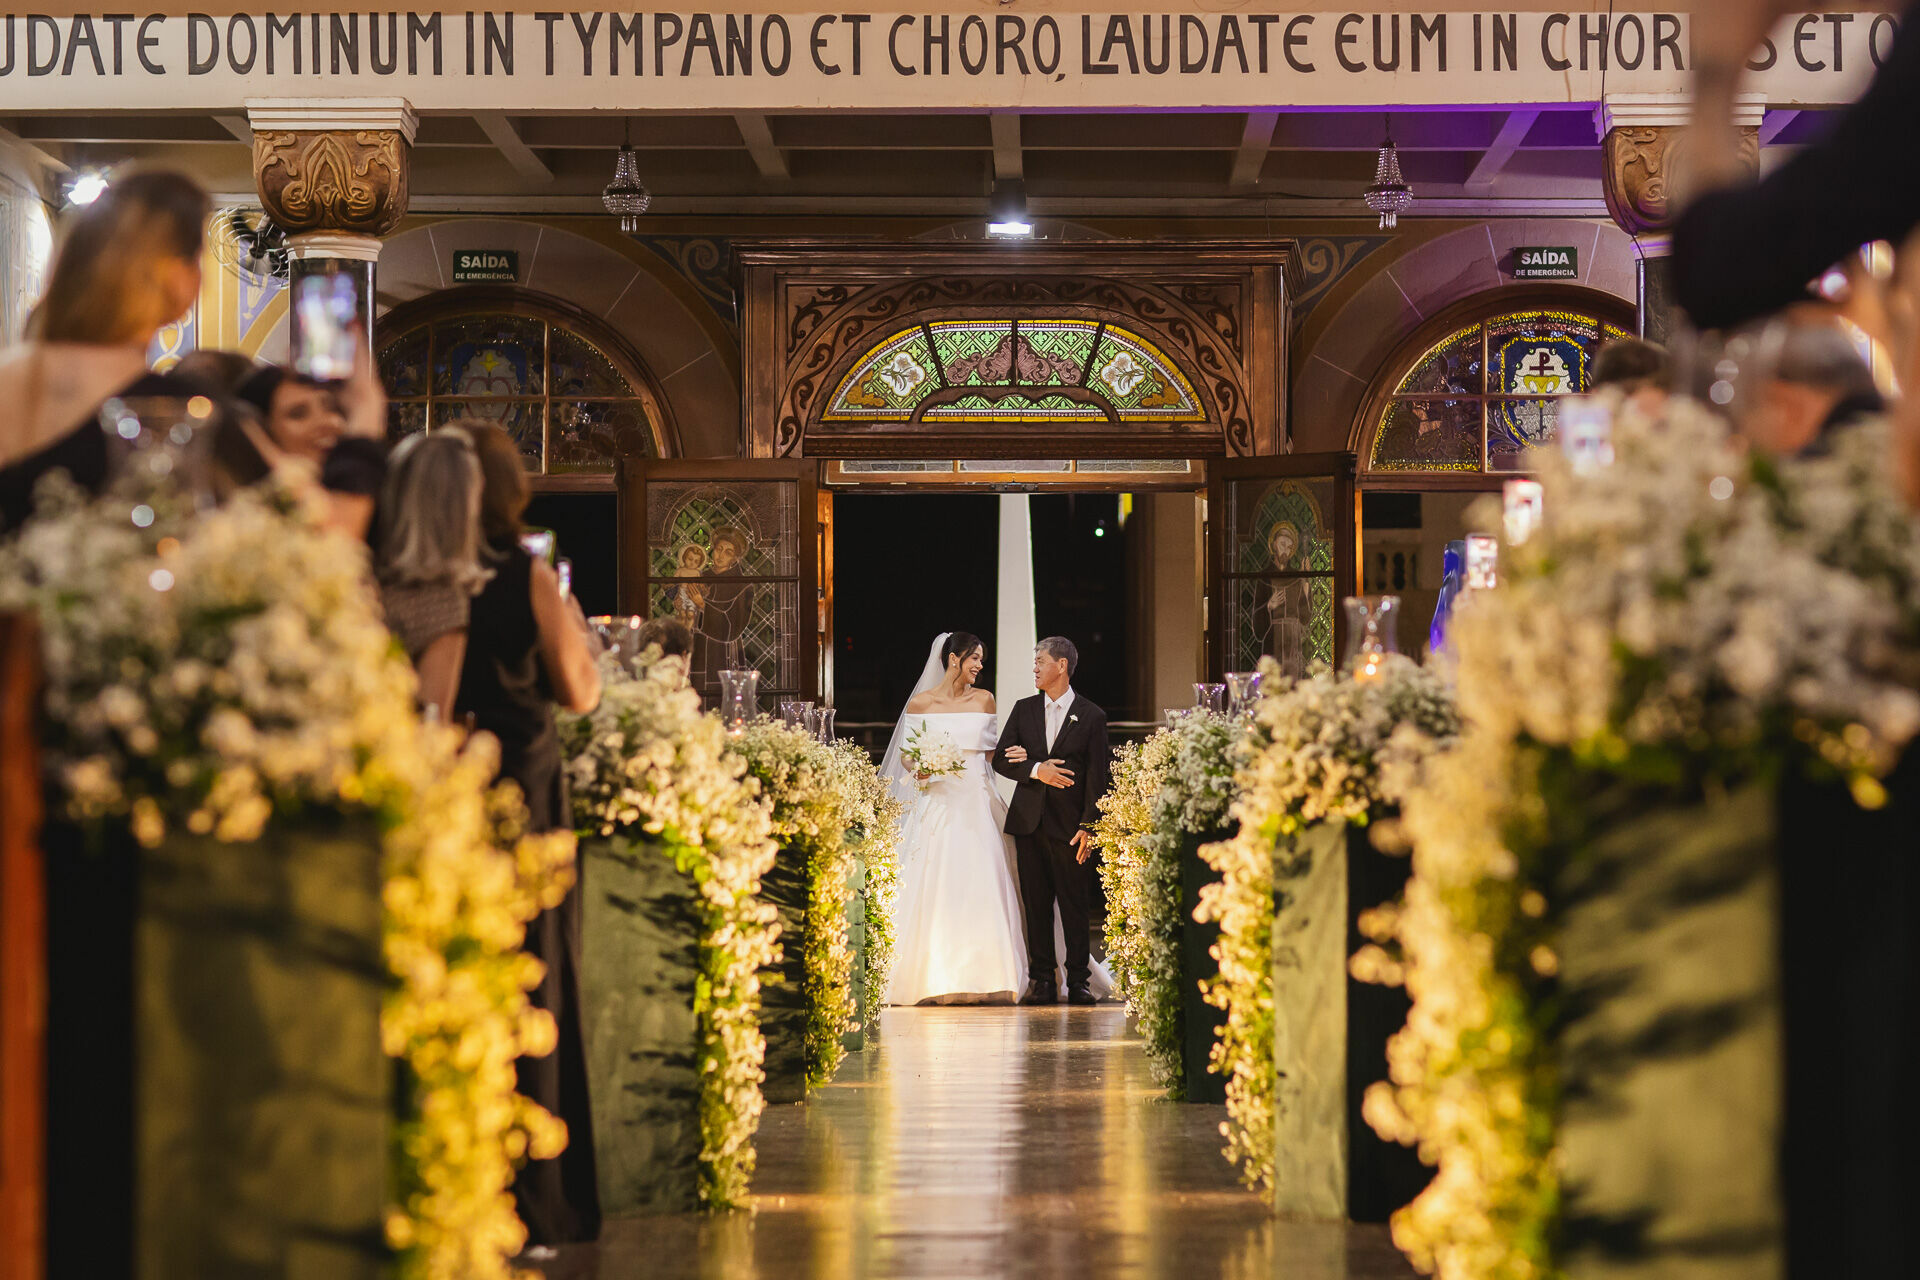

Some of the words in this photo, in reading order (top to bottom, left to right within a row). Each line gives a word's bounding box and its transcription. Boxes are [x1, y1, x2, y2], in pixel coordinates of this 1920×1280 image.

[187, 12, 442, 75] DOMINUM
[465, 11, 514, 76] IN
[535, 12, 791, 76] TYMPANO
[810, 14, 871, 76] ET
[889, 15, 1066, 82] CHORO,
[1082, 14, 1316, 75] LAUDATE
[1335, 14, 1447, 73] EUM
[1473, 14, 1518, 72] IN
[1794, 14, 1854, 72] ET
[461, 253, 508, 268] SAÍDA
[1521, 250, 1569, 264] SAÍDA
[1527, 268, 1575, 276] EMERGÊNCIA
